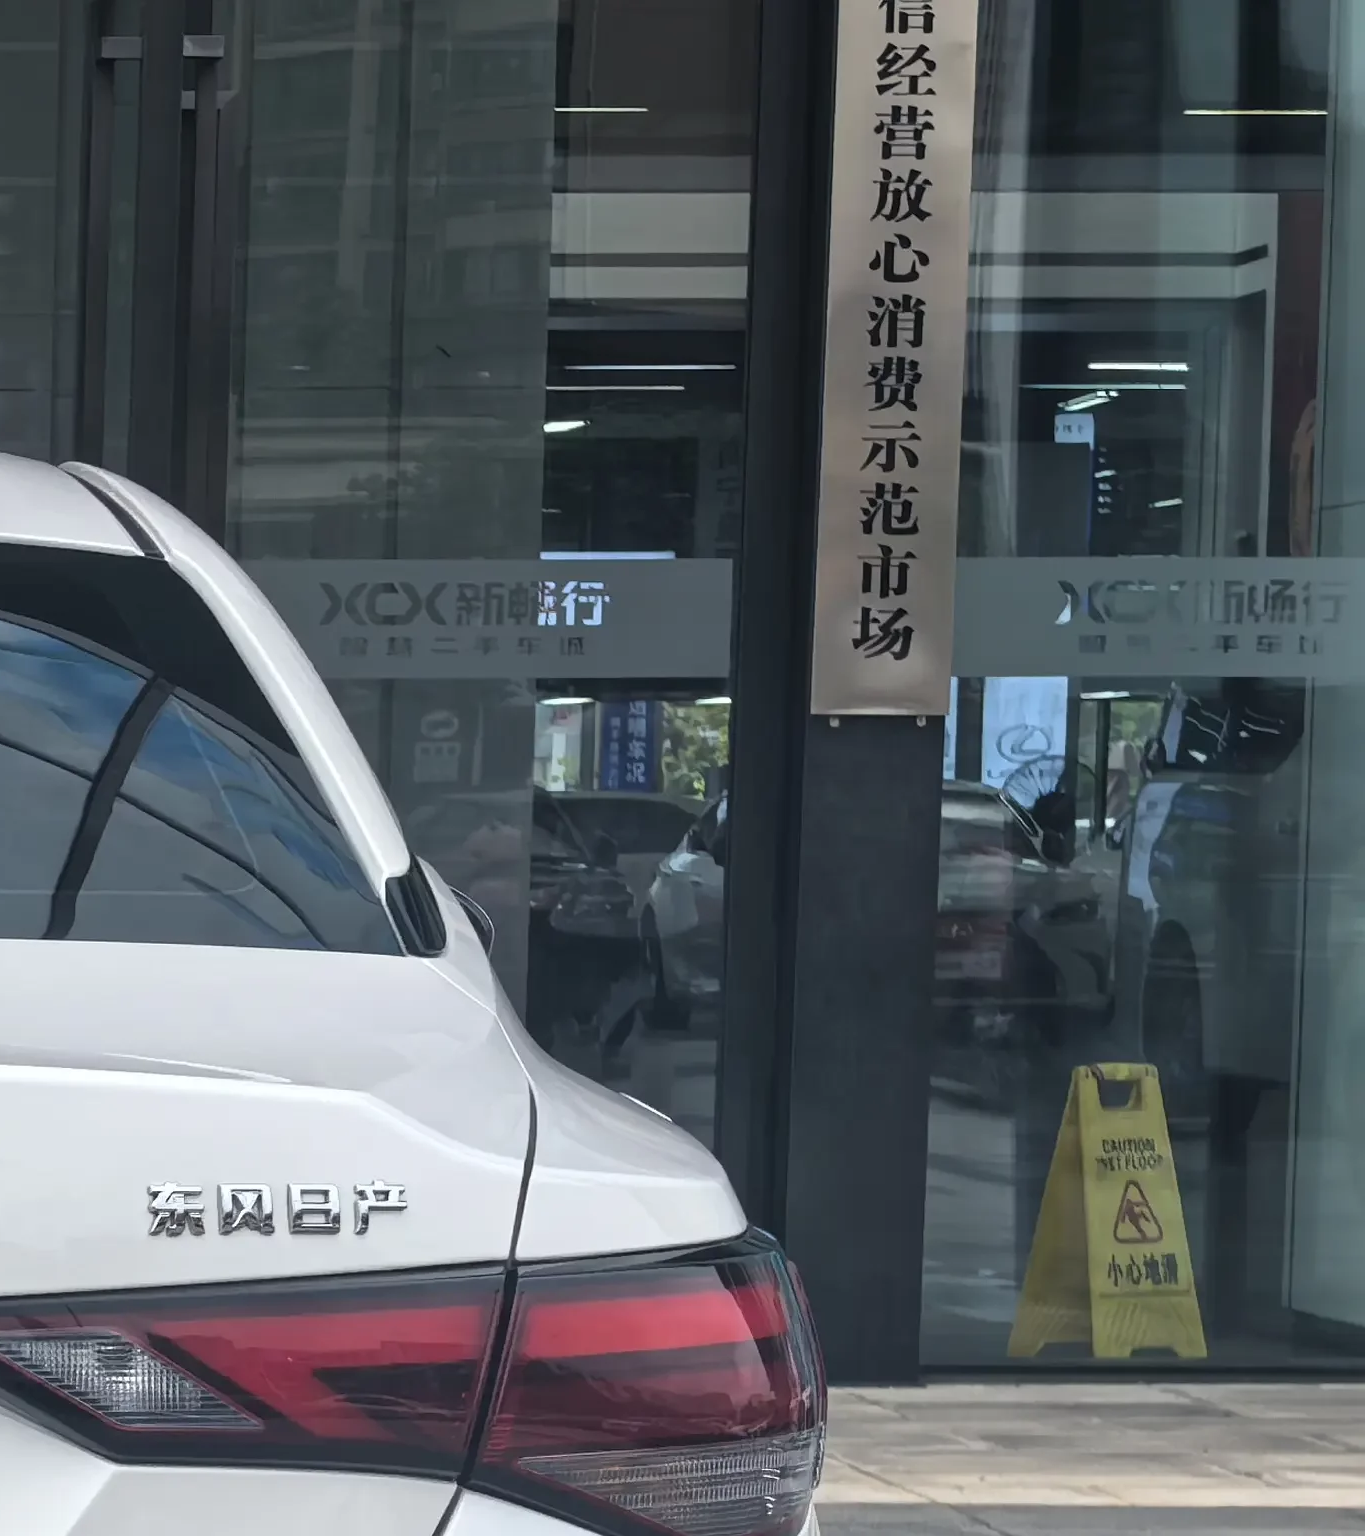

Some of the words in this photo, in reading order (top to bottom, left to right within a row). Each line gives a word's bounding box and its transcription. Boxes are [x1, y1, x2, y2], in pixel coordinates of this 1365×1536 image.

[852, 0, 937, 662] 信经营放心消费示范市场
[147, 1180, 409, 1236] 东风日产
